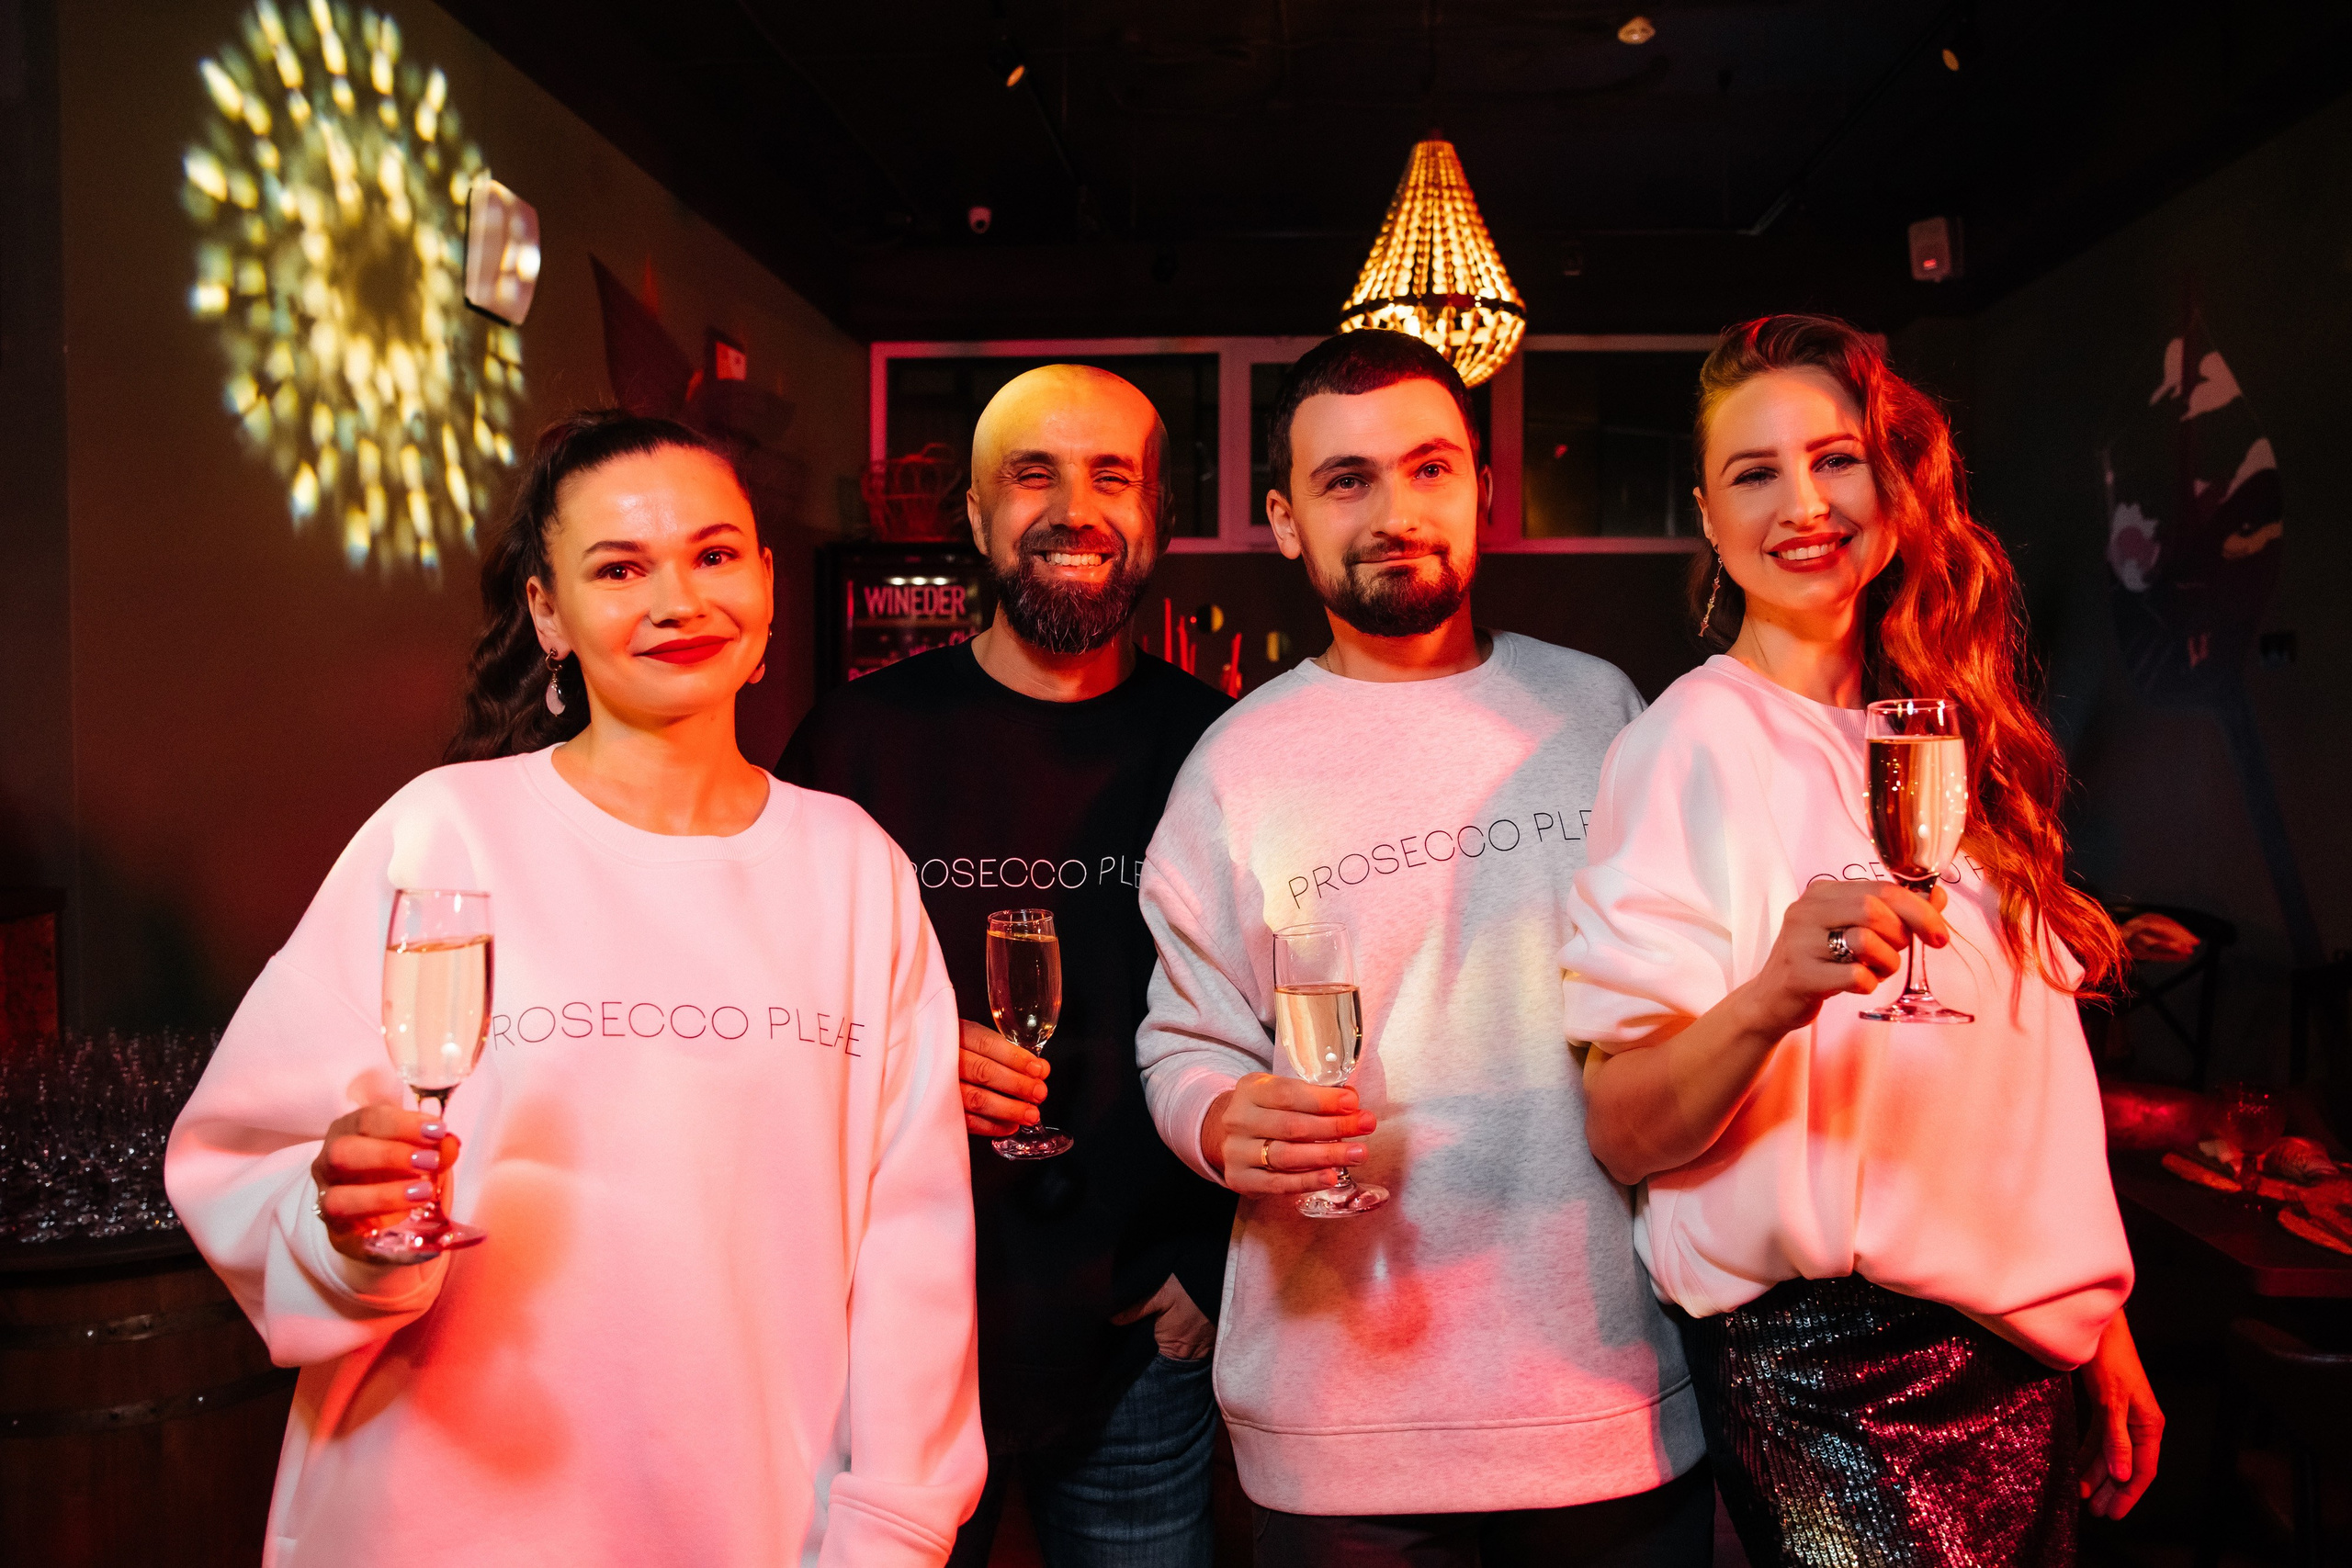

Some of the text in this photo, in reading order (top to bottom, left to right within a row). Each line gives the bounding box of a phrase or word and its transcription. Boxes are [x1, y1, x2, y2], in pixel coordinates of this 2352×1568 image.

[910, 854, 1144, 889] OSECCO PLE
[1287, 809, 1592, 909] PROSECCO PLE
[492, 1001, 749, 1051] ROSECCO
